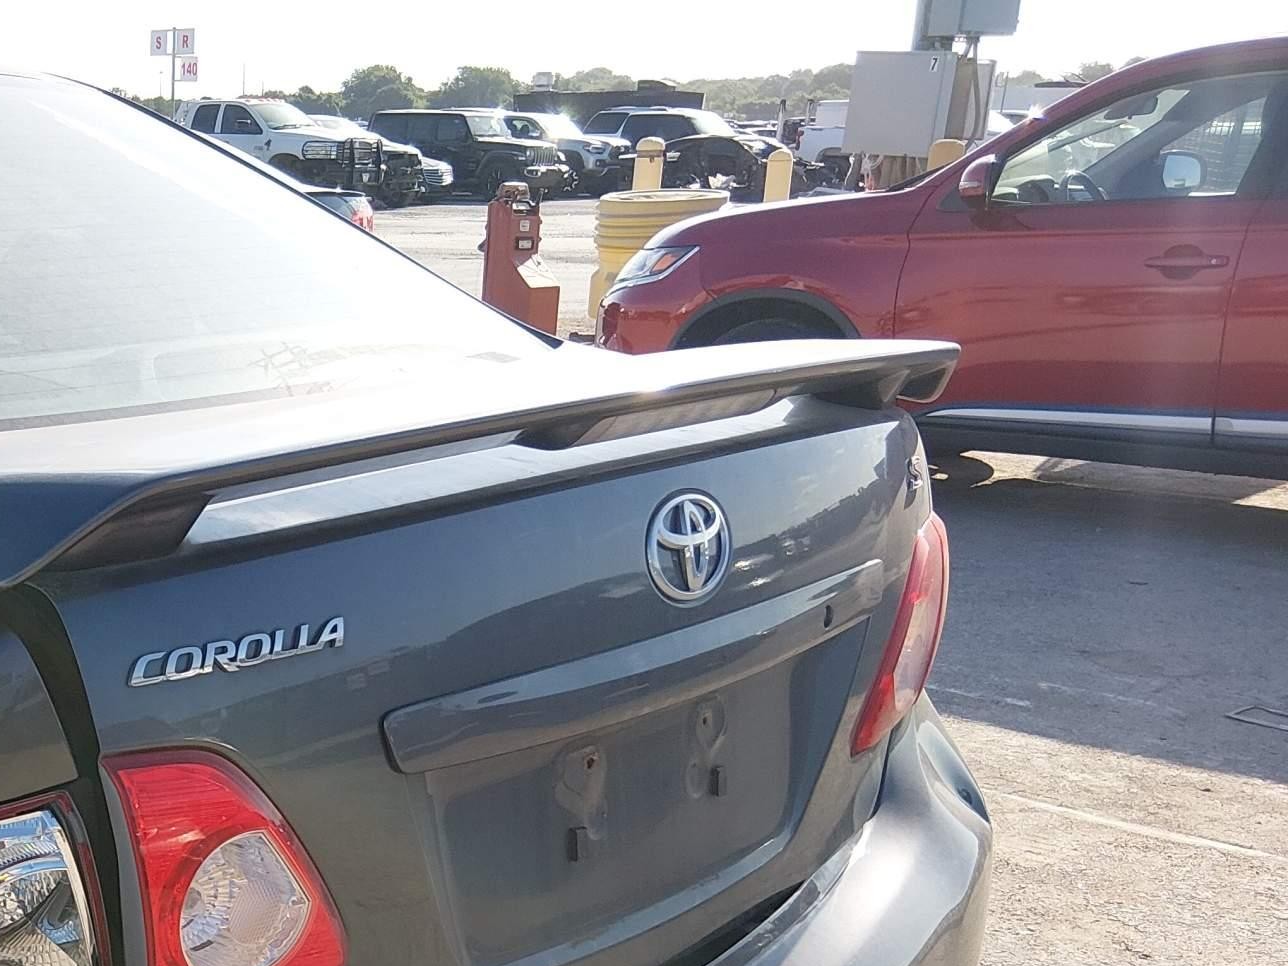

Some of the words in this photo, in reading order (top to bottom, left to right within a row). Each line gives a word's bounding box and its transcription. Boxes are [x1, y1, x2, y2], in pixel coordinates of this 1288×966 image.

[155, 36, 162, 50] S
[182, 34, 189, 48] R
[181, 62, 198, 76] 140
[931, 57, 938, 71] 7
[905, 456, 923, 490] S
[128, 616, 345, 688] COROLLA
